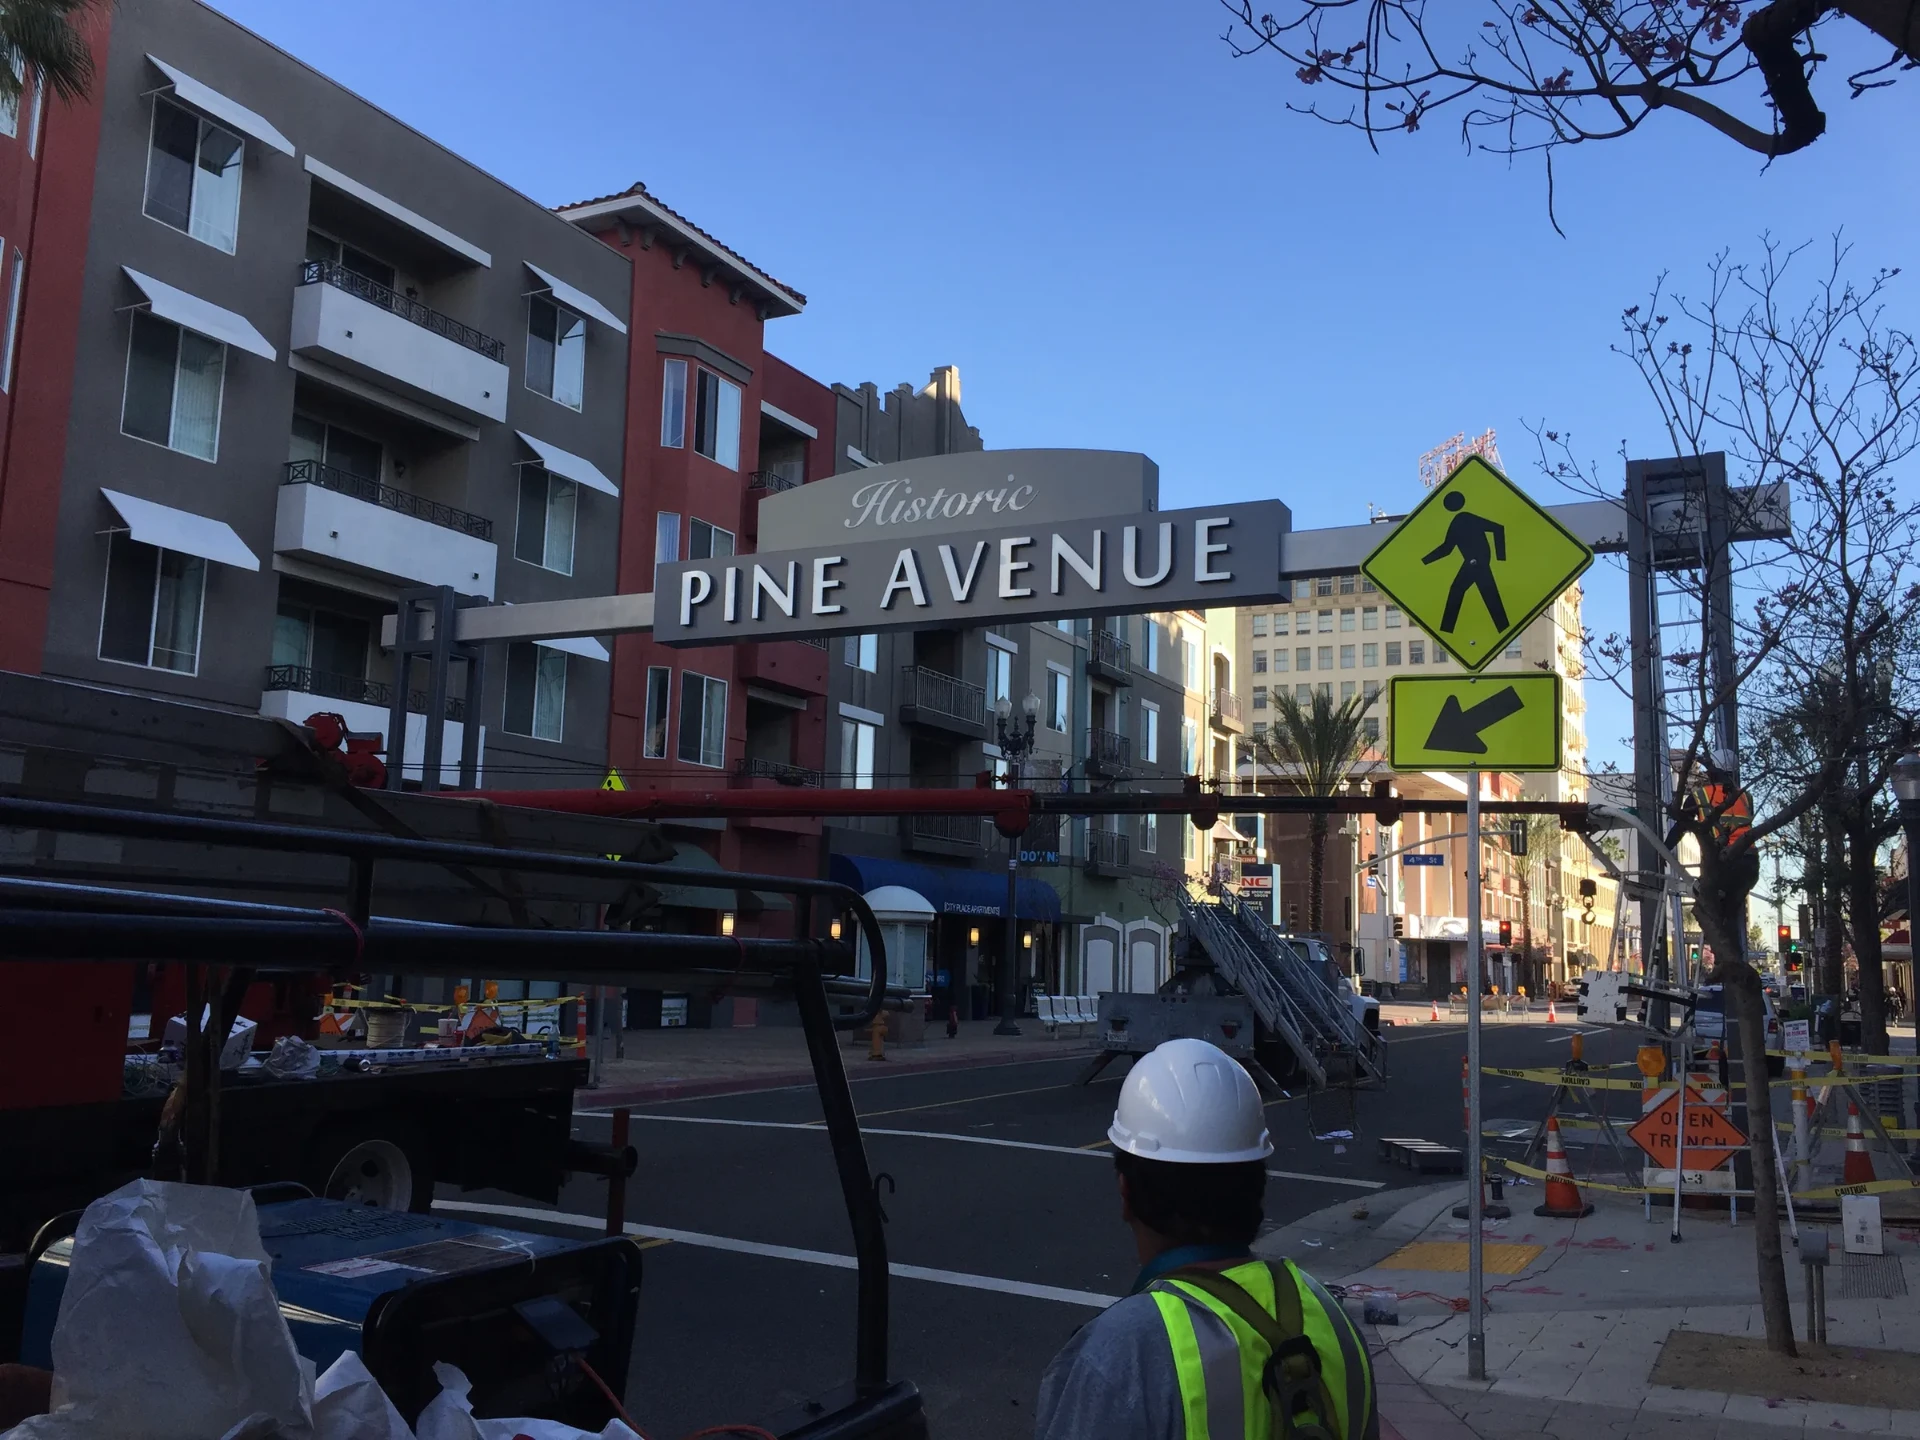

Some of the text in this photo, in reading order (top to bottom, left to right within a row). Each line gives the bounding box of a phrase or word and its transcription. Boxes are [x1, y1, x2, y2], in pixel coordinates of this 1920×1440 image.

[844, 473, 1040, 529] Historic
[679, 516, 1232, 627] PINE AVENUE
[1647, 1132, 1727, 1150] TRNCH
[1545, 1174, 1576, 1185] CAUTION
[1834, 1184, 1868, 1197] CAUTION
